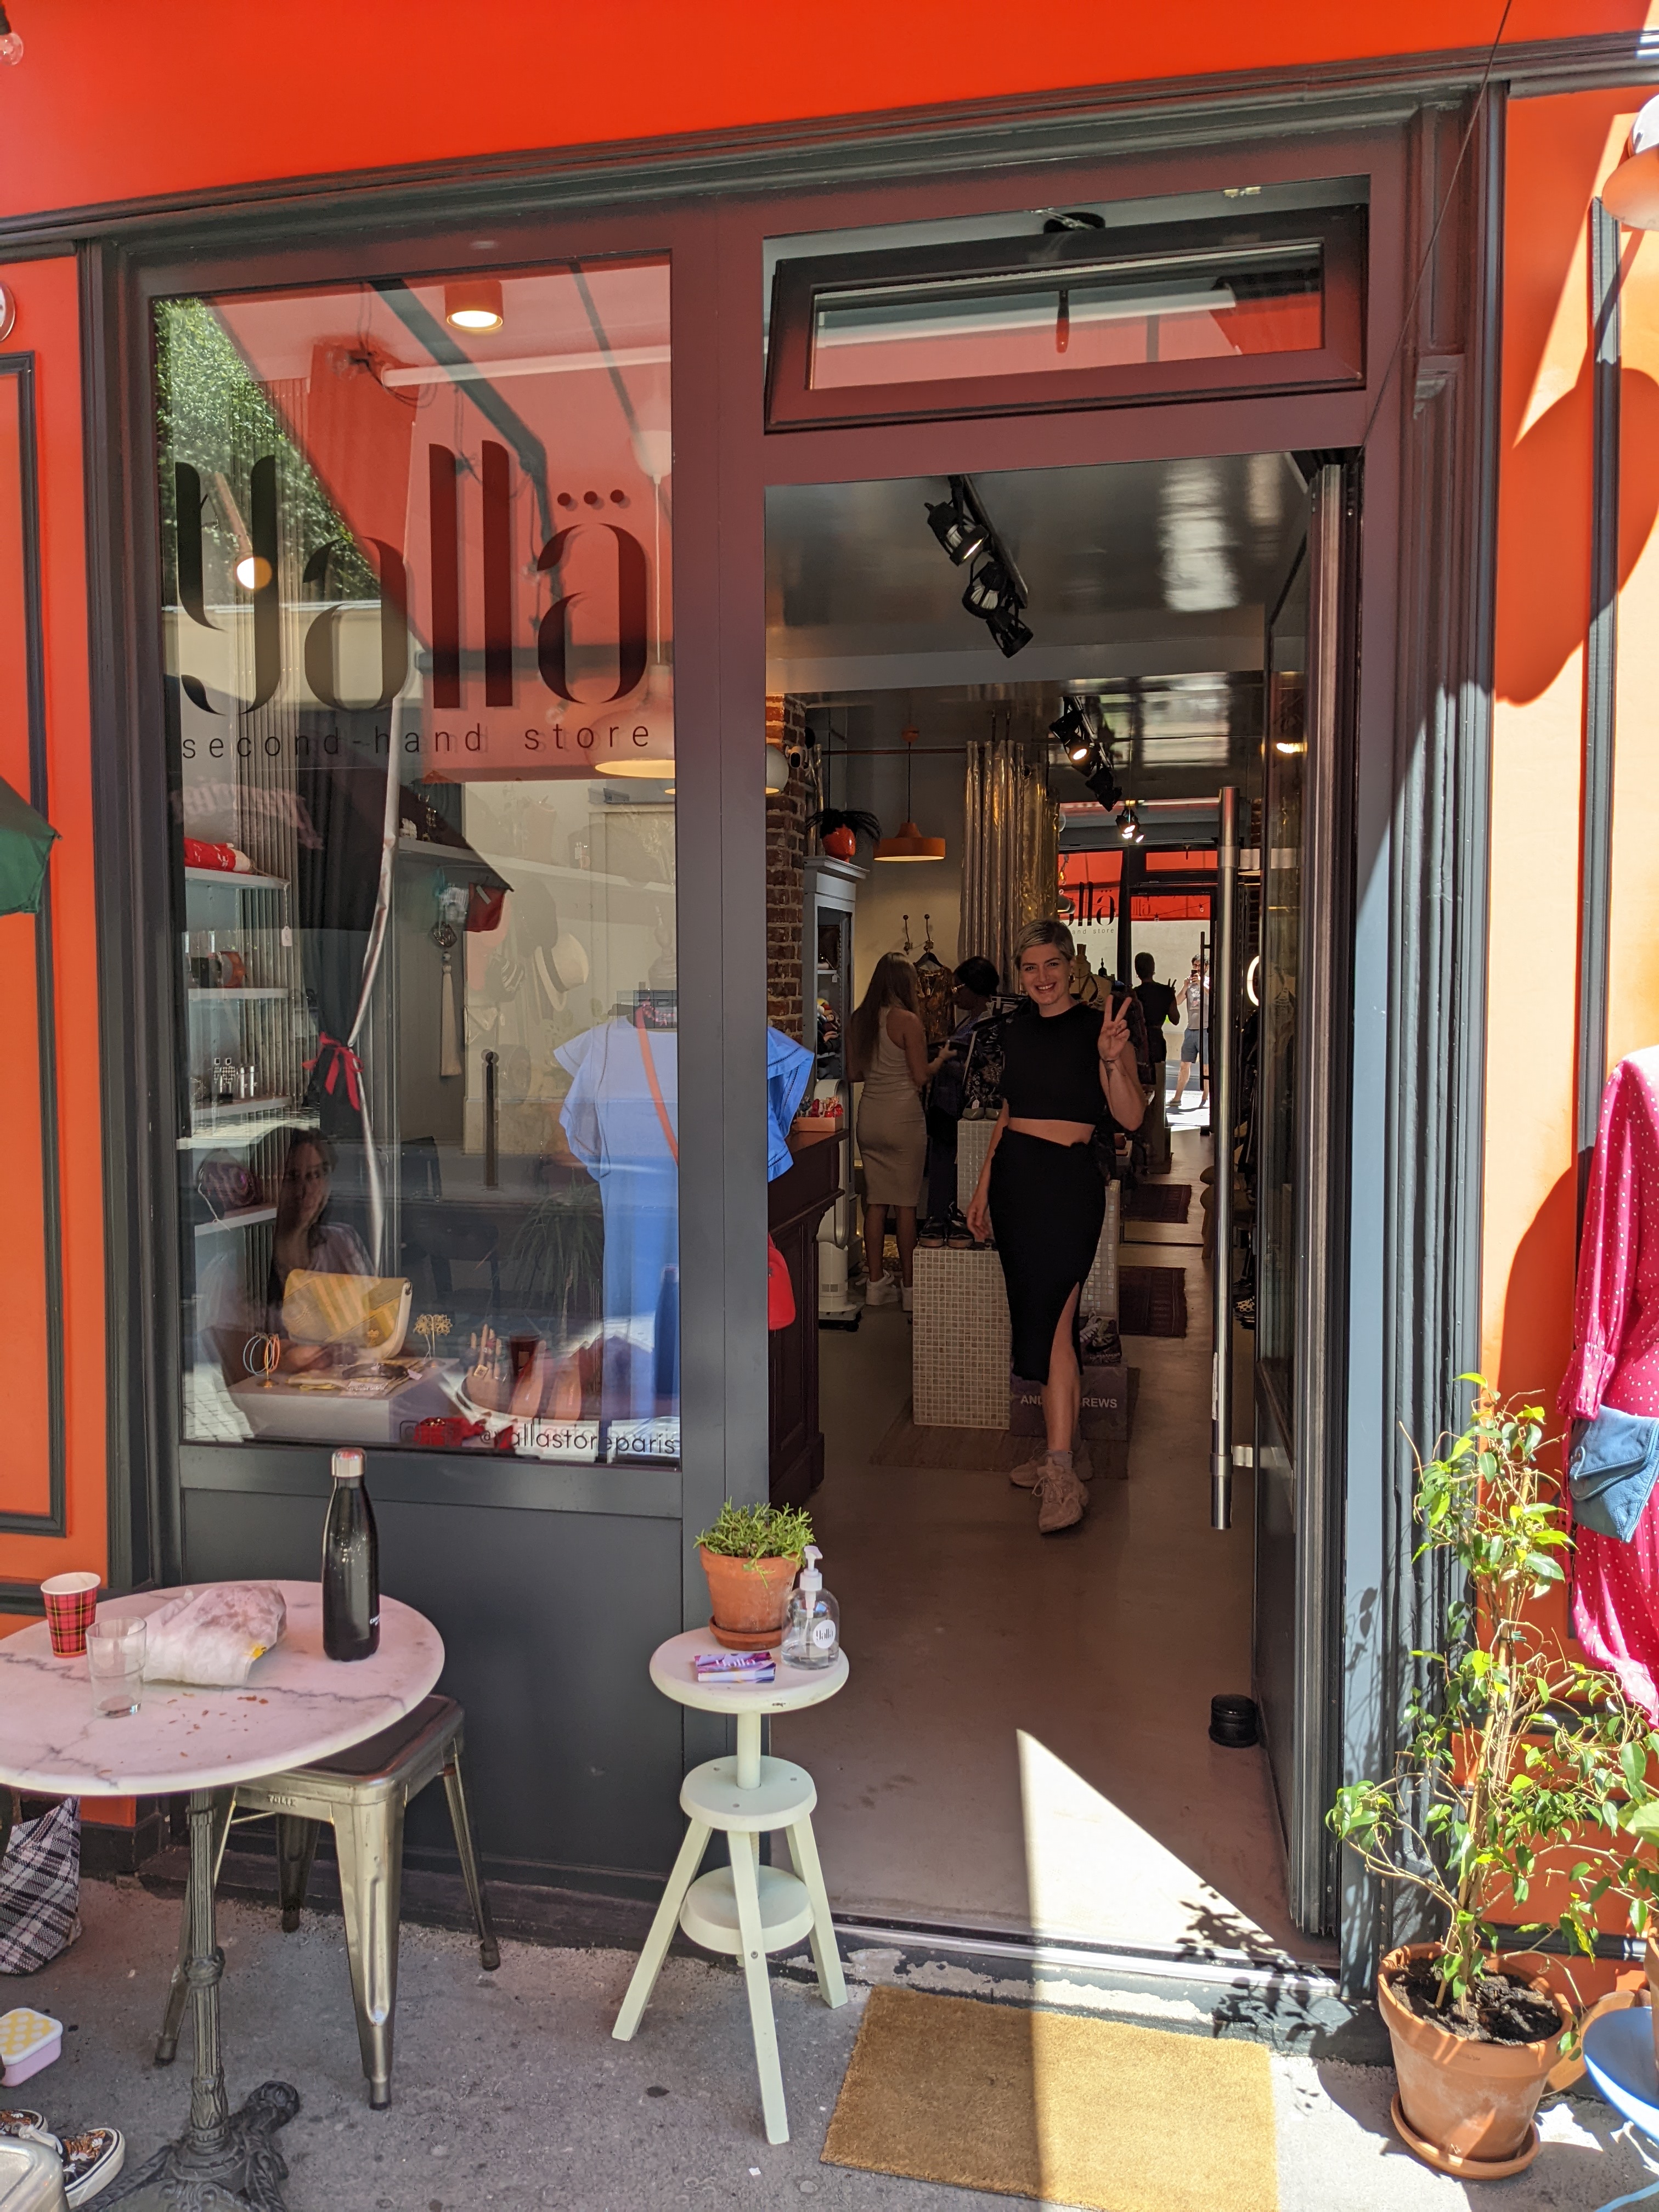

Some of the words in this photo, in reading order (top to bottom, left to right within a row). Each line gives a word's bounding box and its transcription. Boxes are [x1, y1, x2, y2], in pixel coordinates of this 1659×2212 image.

[182, 723, 482, 759] second-hand
[524, 724, 650, 751] store
[479, 1423, 675, 1457] @yallastoreparis
